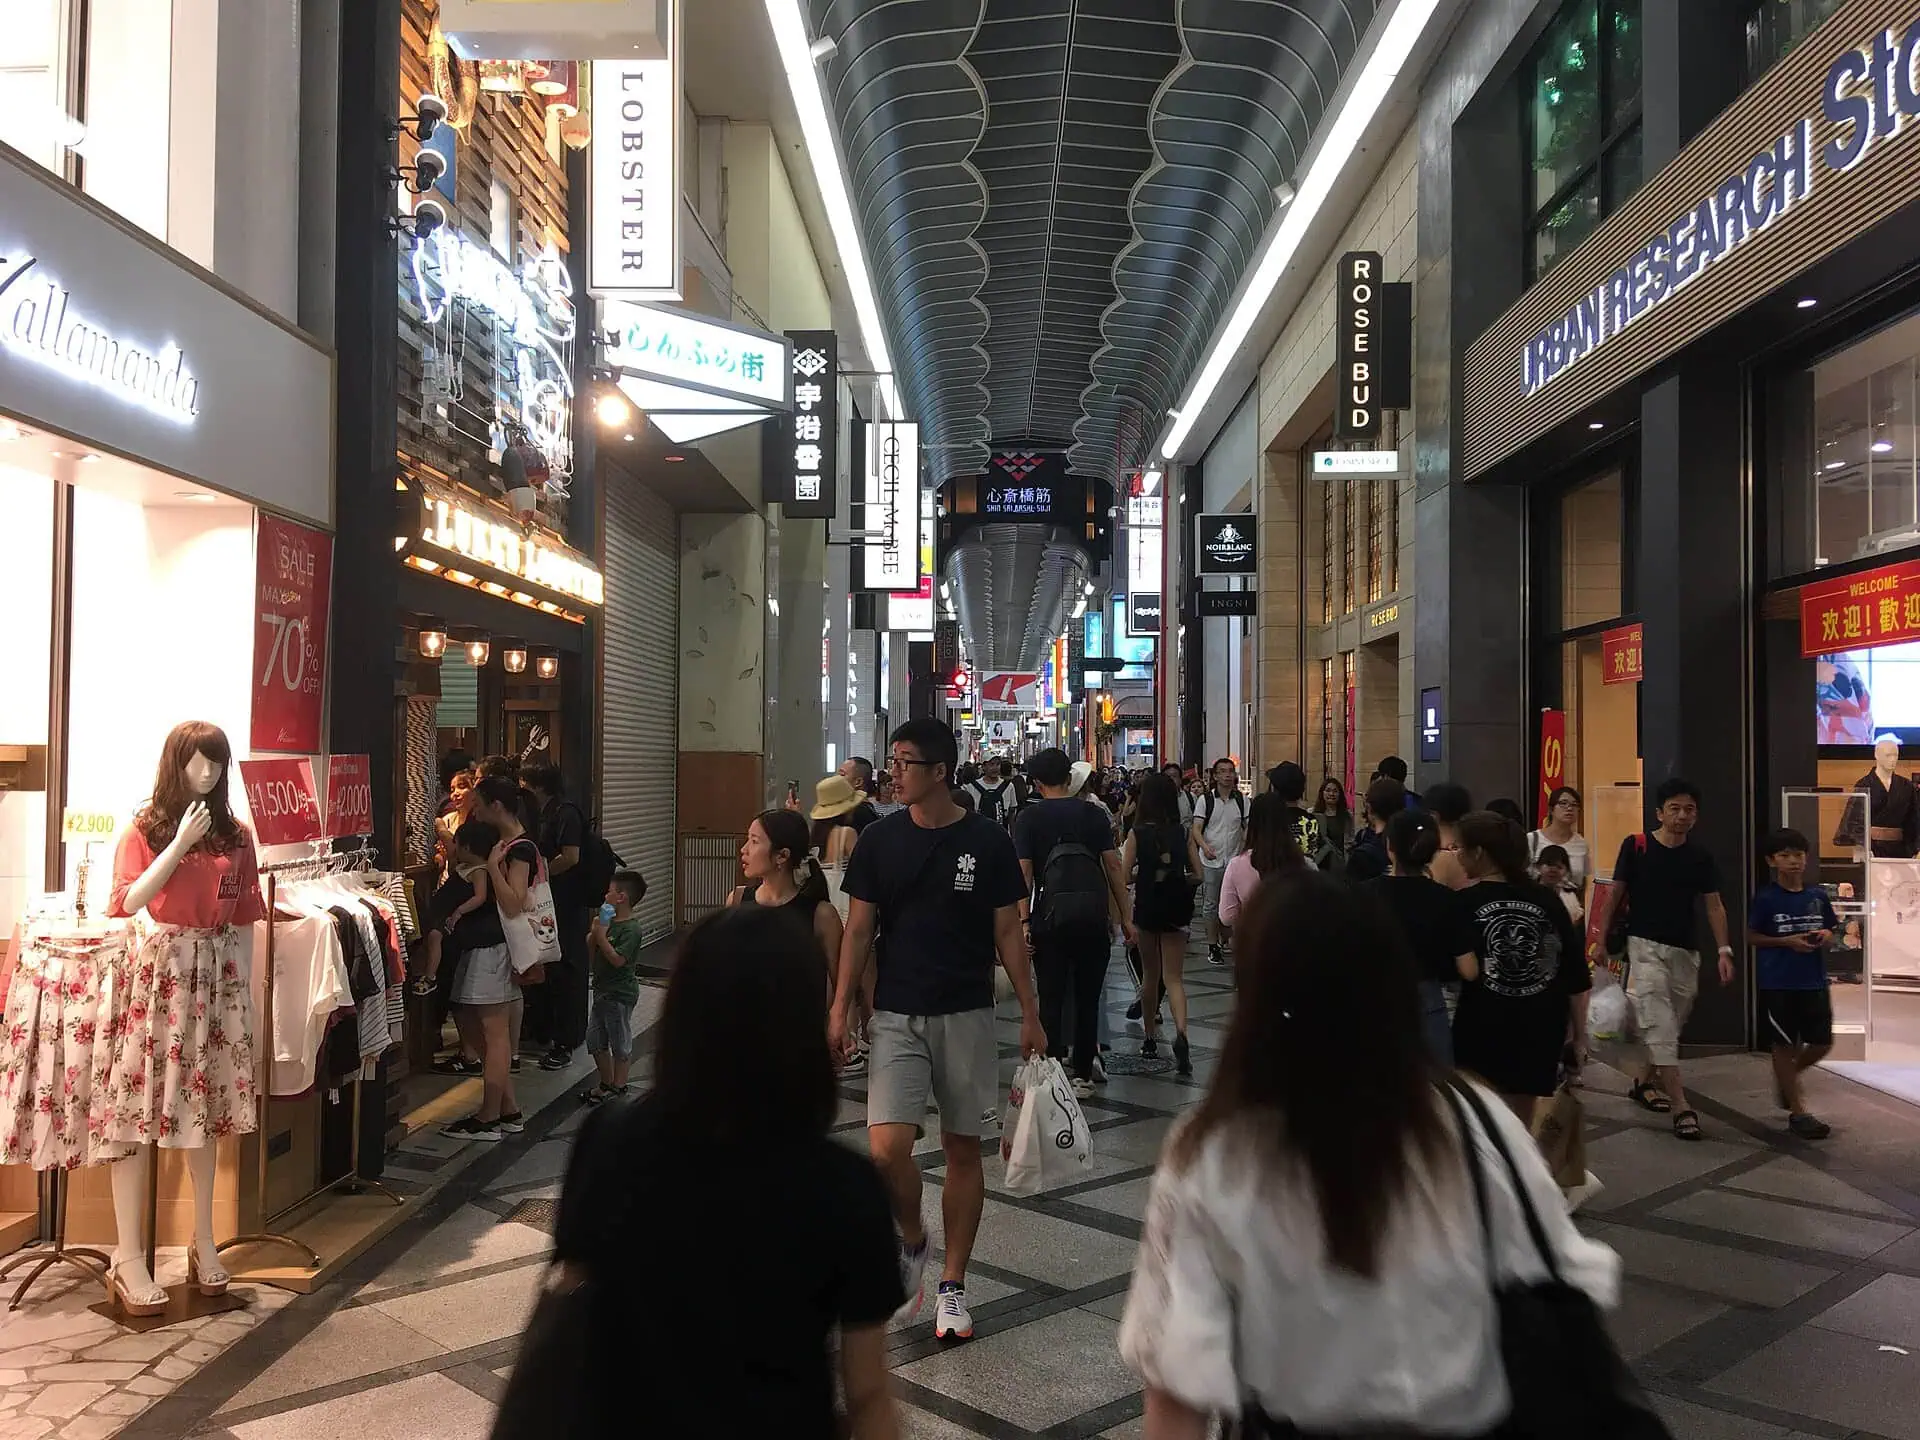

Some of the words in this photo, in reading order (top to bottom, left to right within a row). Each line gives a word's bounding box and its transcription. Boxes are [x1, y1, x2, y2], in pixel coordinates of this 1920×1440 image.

[622, 72, 643, 272] LOBSTER
[1520, 285, 1606, 397] URBAN
[1606, 119, 1811, 336] RESEARCH
[0, 257, 200, 416] allamanda
[1353, 259, 1371, 353] ROSE
[1352, 362, 1370, 428] BUD
[883, 436, 900, 502] CECIL
[986, 487, 1053, 504] 心斎橋筋
[281, 545, 315, 576] SALE
[1849, 575, 1899, 597] WELCOME
